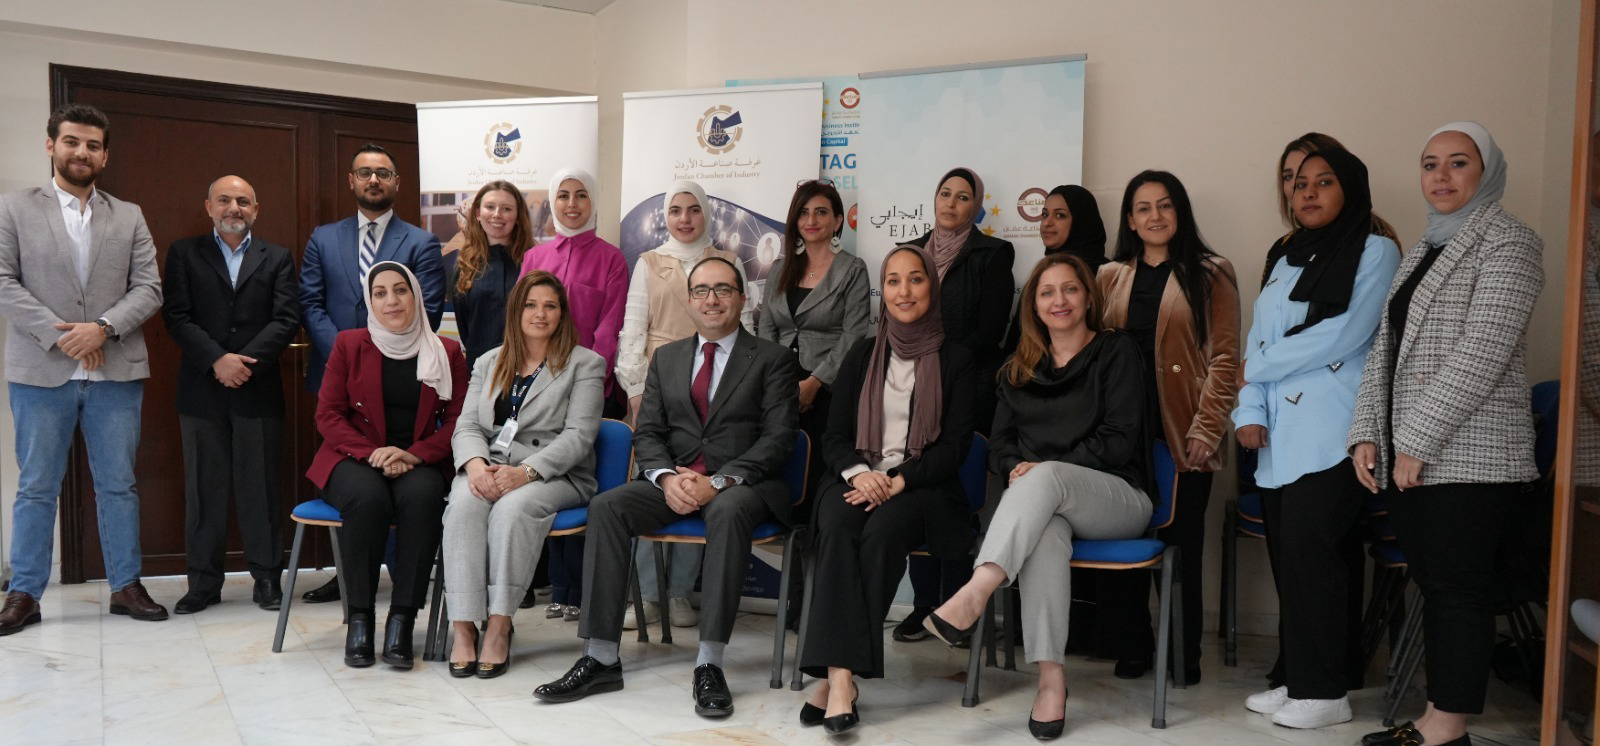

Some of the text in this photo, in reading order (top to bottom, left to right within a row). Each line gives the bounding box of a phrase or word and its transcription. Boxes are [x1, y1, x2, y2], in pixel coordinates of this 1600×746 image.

[820, 153, 856, 169] TAG
[673, 172, 695, 181] Jordan
[696, 171, 725, 180] Chamber
[734, 171, 761, 179] Industry
[870, 203, 924, 229] إيجابي
[889, 223, 932, 239] EJAB
